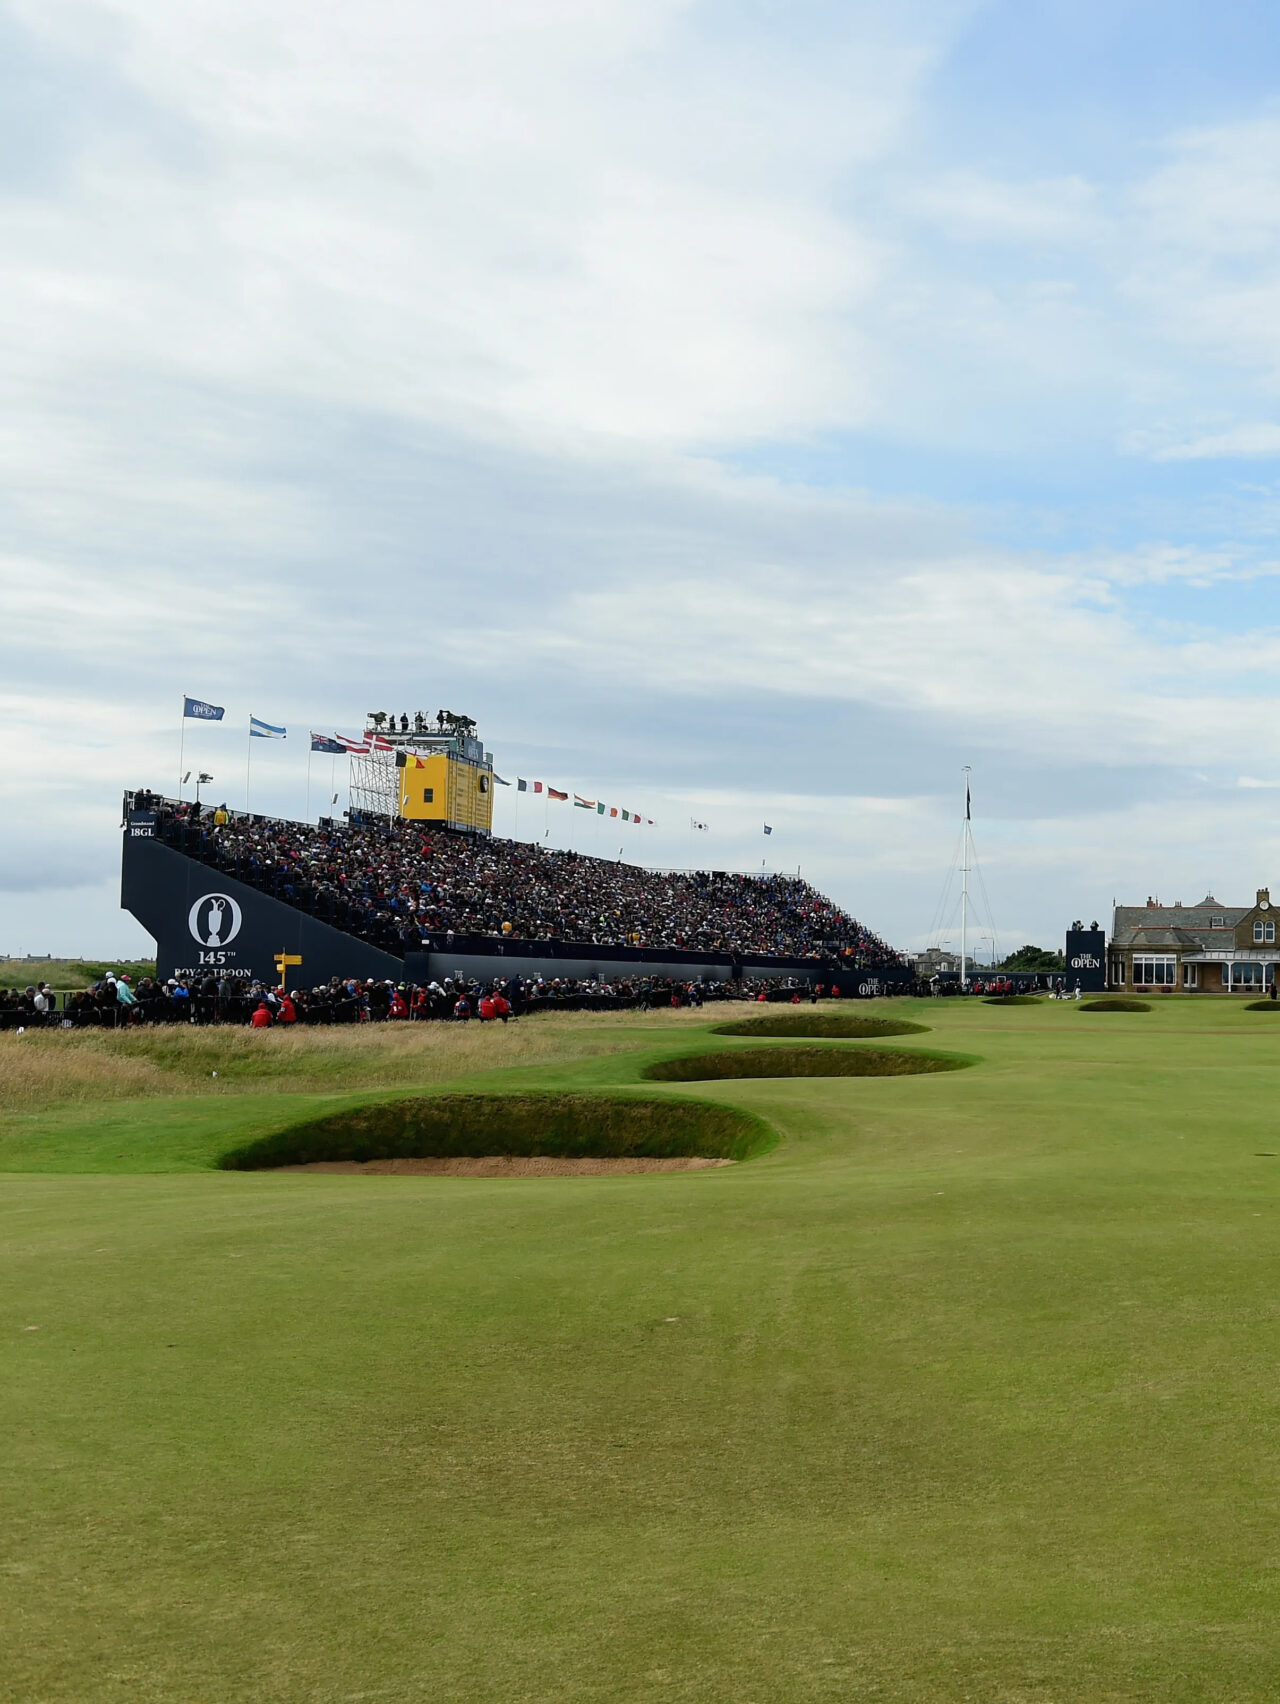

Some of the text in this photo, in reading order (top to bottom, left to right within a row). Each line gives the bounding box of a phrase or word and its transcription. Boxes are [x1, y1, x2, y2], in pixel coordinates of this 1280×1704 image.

[192, 705, 217, 715] OPEN
[130, 828, 154, 837] 18GL
[1070, 957, 1100, 969] OPEN
[866, 977, 879, 985] THE
